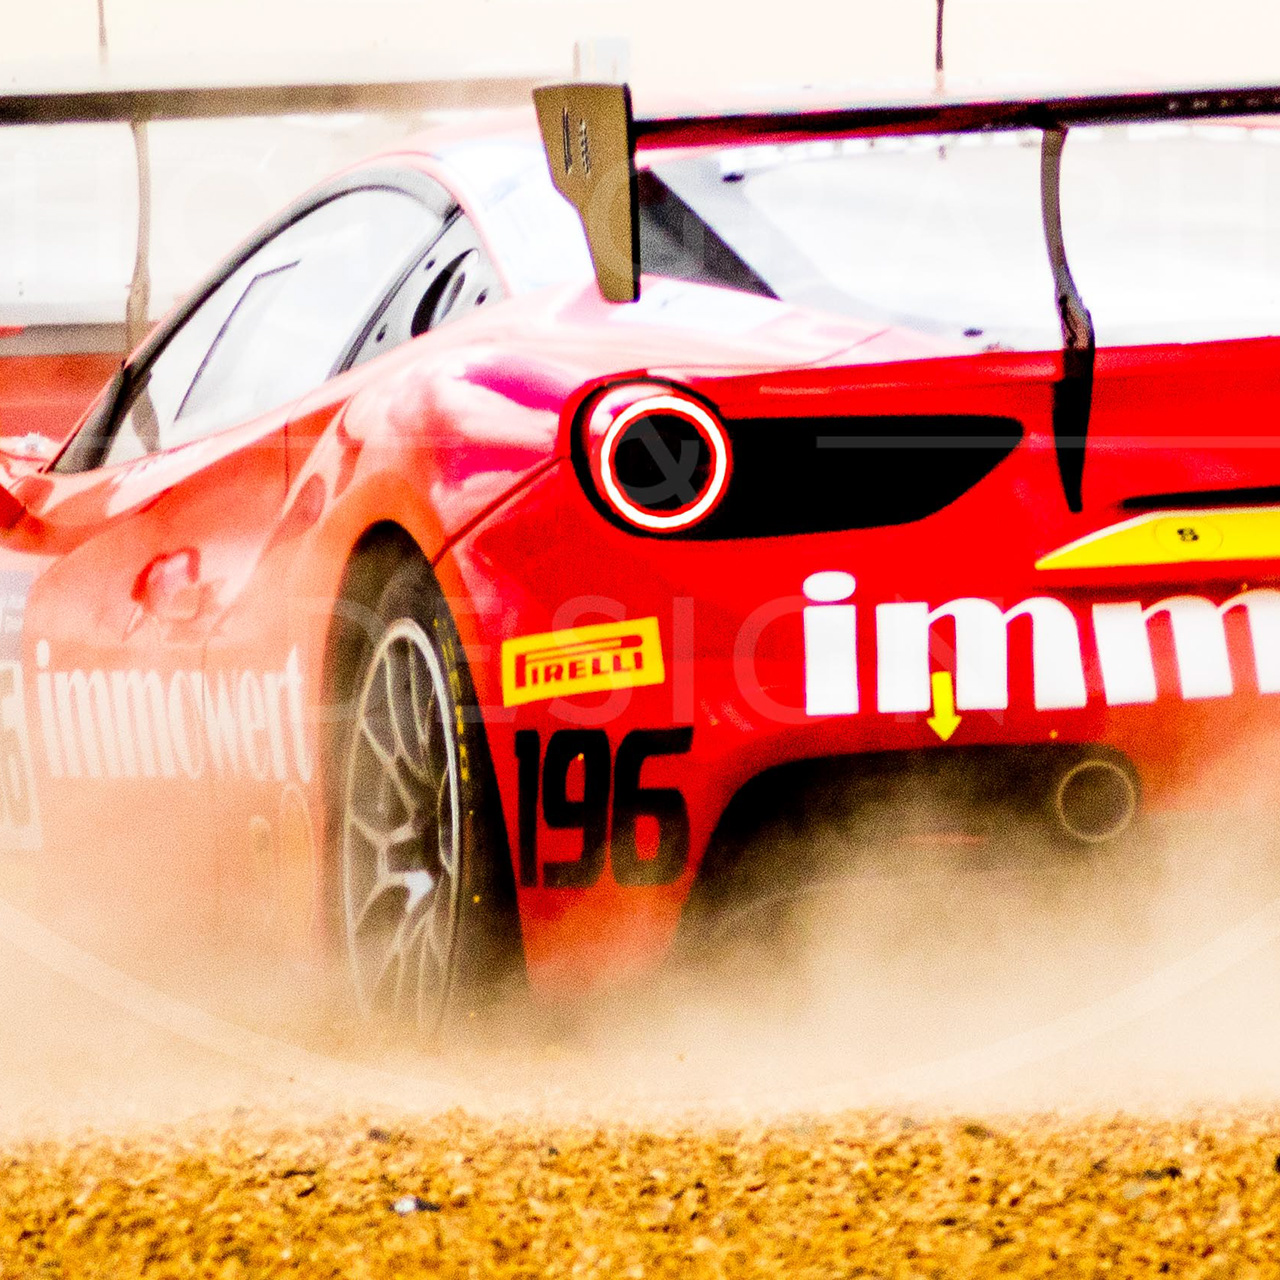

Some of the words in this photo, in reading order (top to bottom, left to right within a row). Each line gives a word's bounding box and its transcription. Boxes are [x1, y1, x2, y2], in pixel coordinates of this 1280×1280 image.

[34, 638, 313, 785] immowert
[514, 634, 643, 690] PIRELLI
[515, 726, 694, 888] 196
